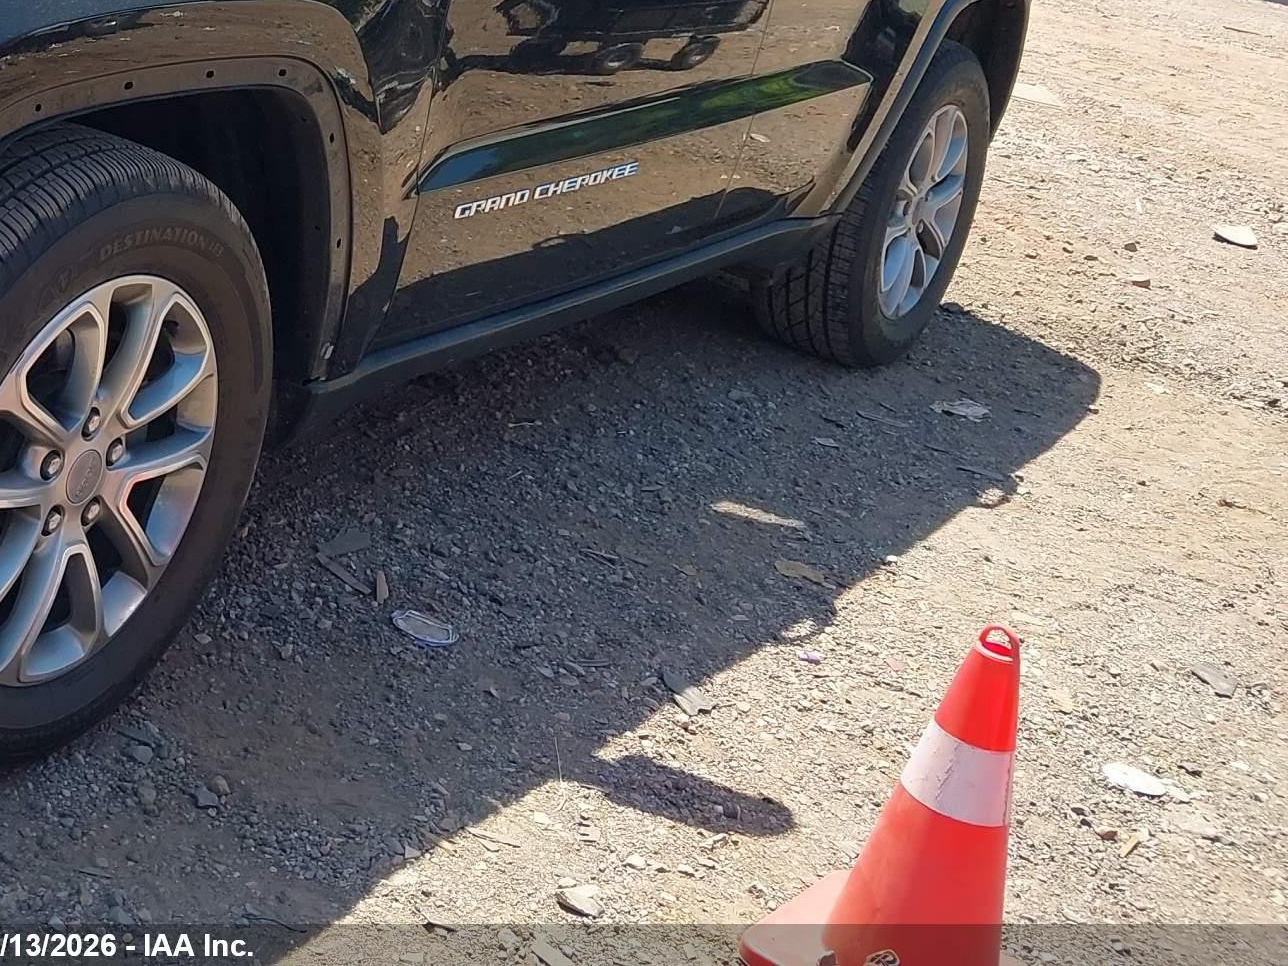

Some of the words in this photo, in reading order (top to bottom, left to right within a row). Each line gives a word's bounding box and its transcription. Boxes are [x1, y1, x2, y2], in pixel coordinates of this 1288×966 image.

[454, 189, 530, 219] GRAND
[533, 160, 640, 201] CHEROKEE
[99, 225, 208, 262] DESTINATION
